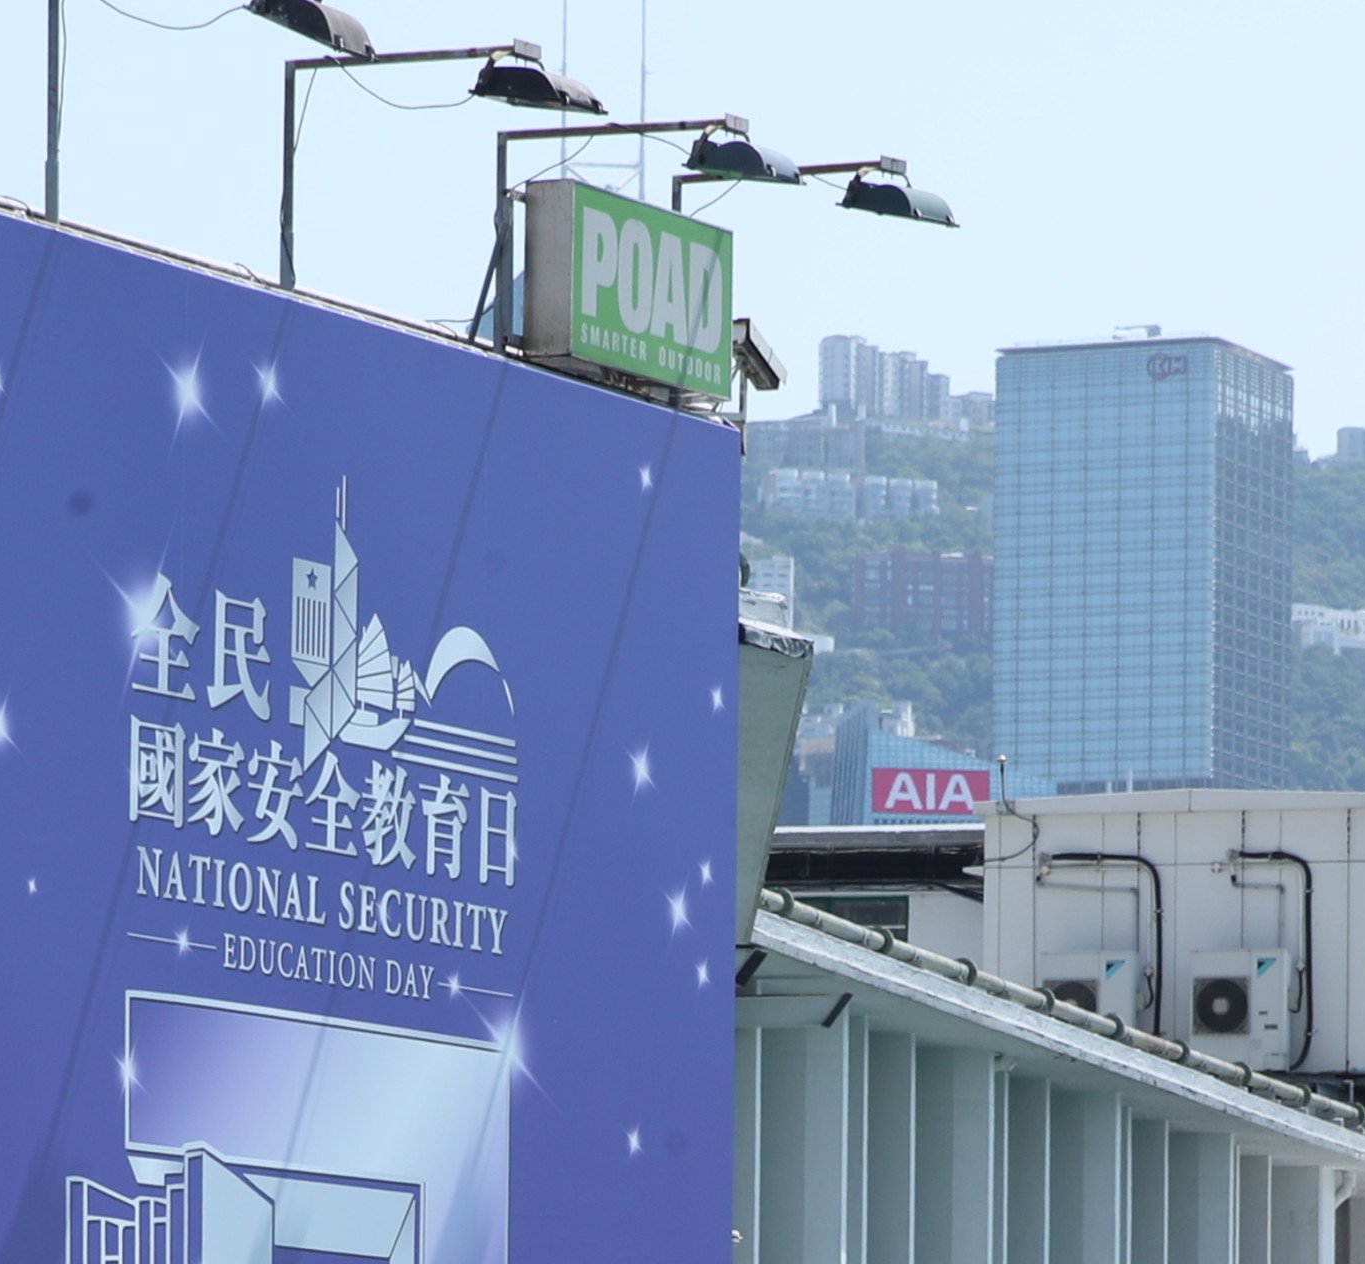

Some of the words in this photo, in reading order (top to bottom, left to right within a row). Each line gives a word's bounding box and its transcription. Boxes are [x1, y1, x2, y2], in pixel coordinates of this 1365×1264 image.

[581, 206, 723, 355] POAD
[581, 323, 647, 361] SMARTER
[658, 345, 721, 385] OUTDOOR
[130, 571, 272, 722] 全民
[128, 713, 518, 888] 國家安全教育日
[884, 772, 975, 811] AIA
[136, 846, 326, 926] NATIONAL
[338, 878, 509, 956] SECURITY
[222, 932, 376, 993] EDUCATION
[385, 958, 435, 1000] DAY
